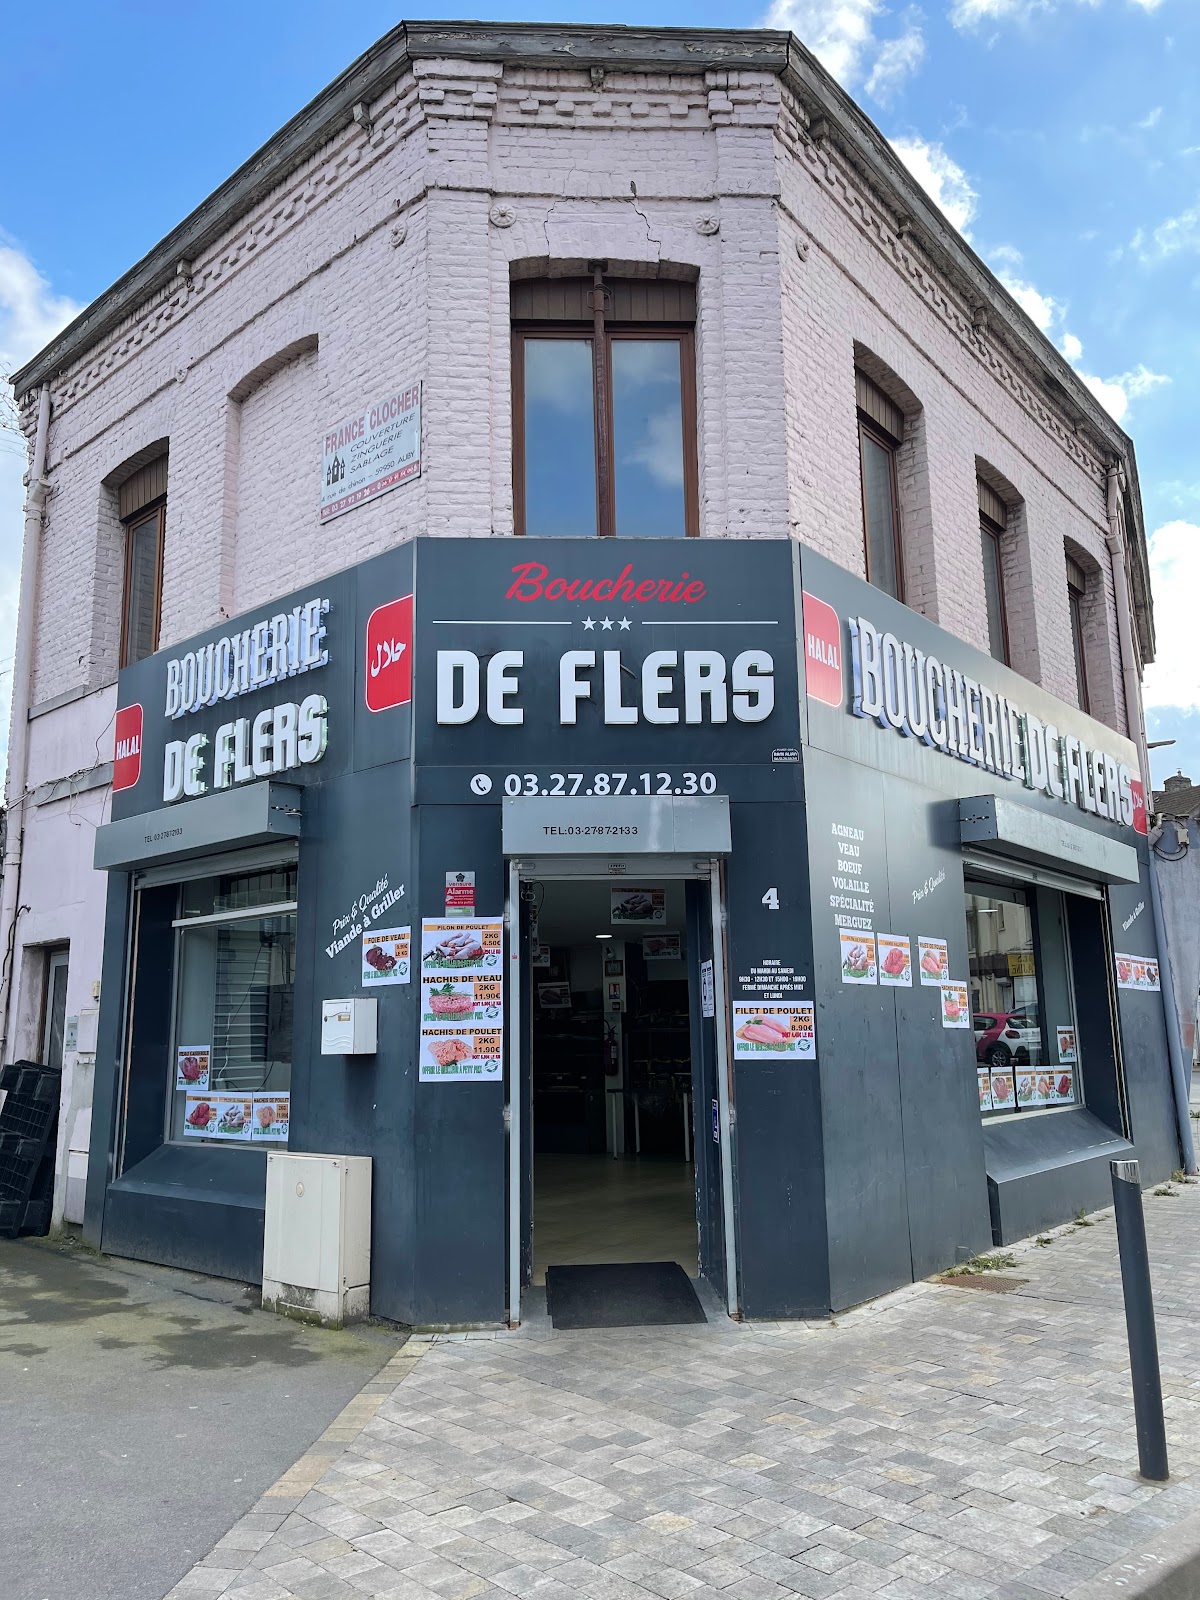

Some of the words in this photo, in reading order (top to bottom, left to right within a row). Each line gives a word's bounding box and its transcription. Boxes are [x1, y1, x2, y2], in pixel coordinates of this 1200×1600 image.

[325, 416, 365, 456] FRANCE
[369, 385, 419, 430] CLOCHER
[350, 413, 415, 452] COUVERTURE
[350, 430, 403, 463] ZINGUERIE
[350, 446, 394, 474] SABLAGE
[397, 450, 415, 465] AUBY
[506, 561, 707, 602] Boucherie
[165, 597, 330, 718] BOUCHERIE
[371, 637, 407, 677] حلال
[808, 633, 840, 671] HALAL
[437, 650, 523, 724] DE
[560, 650, 774, 724] FLERS
[849, 616, 1025, 781] BOUCHERIE
[1025, 711, 1063, 799] DE
[1063, 734, 1134, 828] FLERS
[116, 735, 140, 761] HALAL
[163, 733, 209, 801] DE
[214, 694, 328, 788] FLERS
[504, 772, 716, 796] 03.27.87.12.30
[831, 823, 864, 841] AGNEAU
[837, 842, 860, 857] VEAU
[837, 859, 862, 874] BOEUF
[351, 901, 358, 921] &
[359, 873, 389, 912] Qualité
[762, 887, 780, 909] 4
[832, 876, 870, 893] VOLAILLE
[829, 894, 874, 912] SPÉCIALITÉ
[325, 923, 362, 959] Viande
[363, 914, 371, 928] à
[371, 884, 405, 919] Griller
[834, 913, 872, 930] MERGUEZ
[368, 936, 380, 944] FOIE
[391, 933, 406, 941] VEAU
